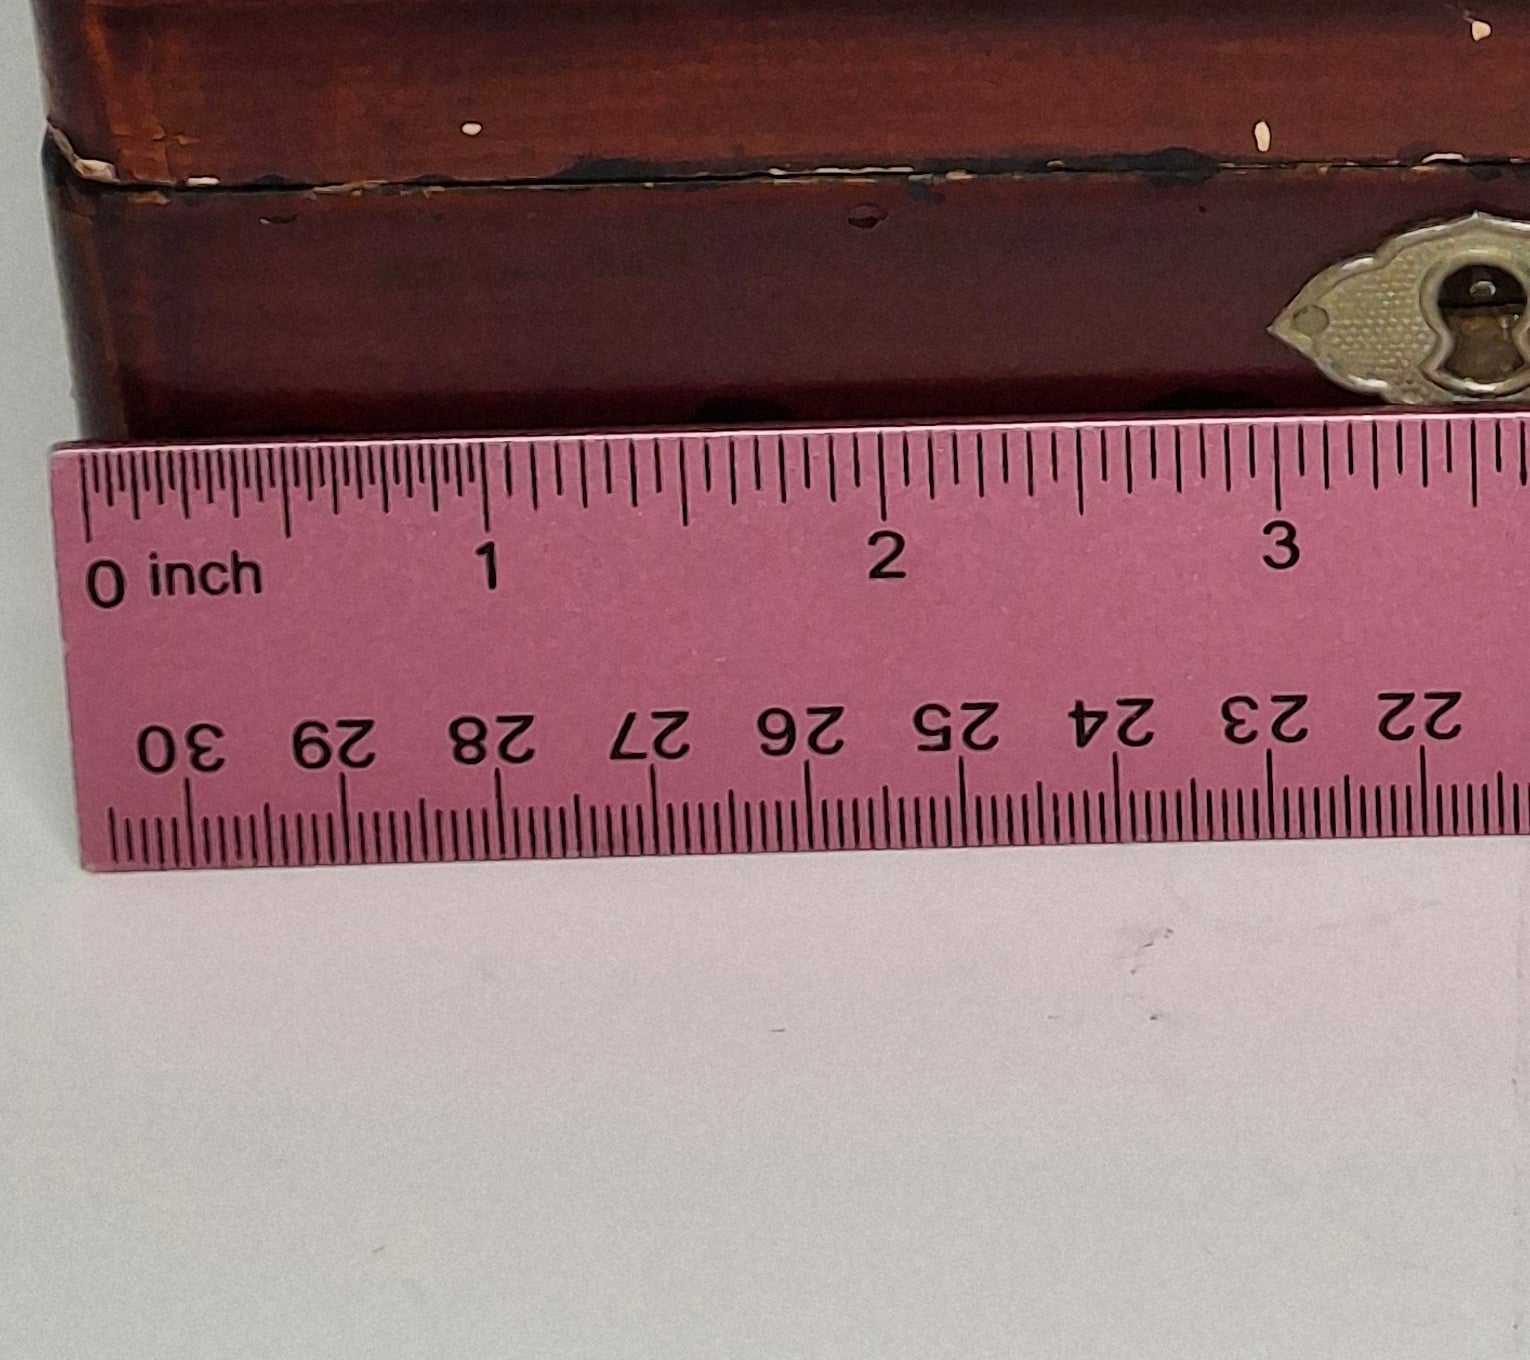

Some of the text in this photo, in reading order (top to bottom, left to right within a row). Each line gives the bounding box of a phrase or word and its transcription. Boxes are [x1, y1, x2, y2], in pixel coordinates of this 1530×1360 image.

[85, 559, 127, 610] 0
[148, 549, 263, 597] inch
[475, 540, 497, 590] 1
[867, 530, 907, 580] 2
[1262, 520, 1300, 570] 3
[448, 714, 536, 766] 28
[609, 710, 691, 761] 27
[756, 705, 845, 757] 26
[912, 701, 1000, 752] 25
[1067, 697, 1155, 749] 24
[1221, 694, 1309, 745] 23
[1377, 691, 1463, 742] 22
[136, 723, 226, 775] 30
[292, 718, 376, 770] 29
